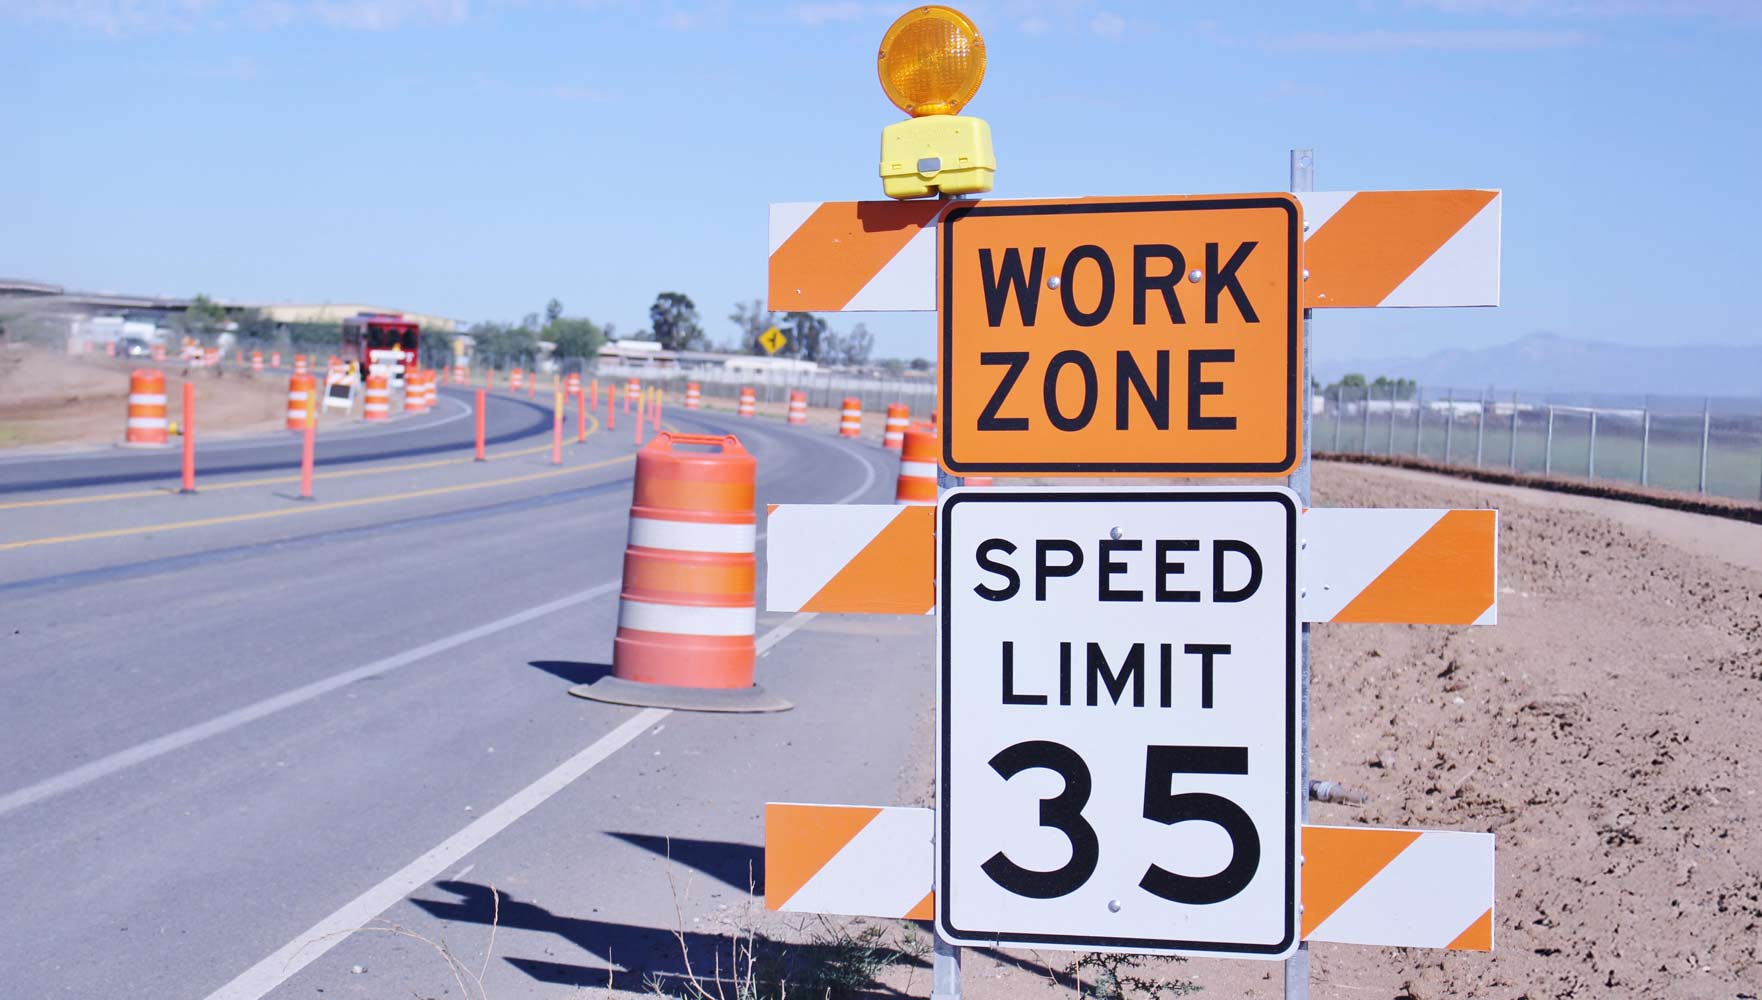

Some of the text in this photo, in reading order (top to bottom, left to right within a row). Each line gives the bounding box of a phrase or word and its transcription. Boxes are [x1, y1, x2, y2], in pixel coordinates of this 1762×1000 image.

[978, 241, 1260, 327] WORK
[977, 349, 1237, 432] ZONE
[974, 538, 1263, 603] SPEED
[1002, 641, 1232, 709] LIMIT
[980, 740, 1261, 905] 35
